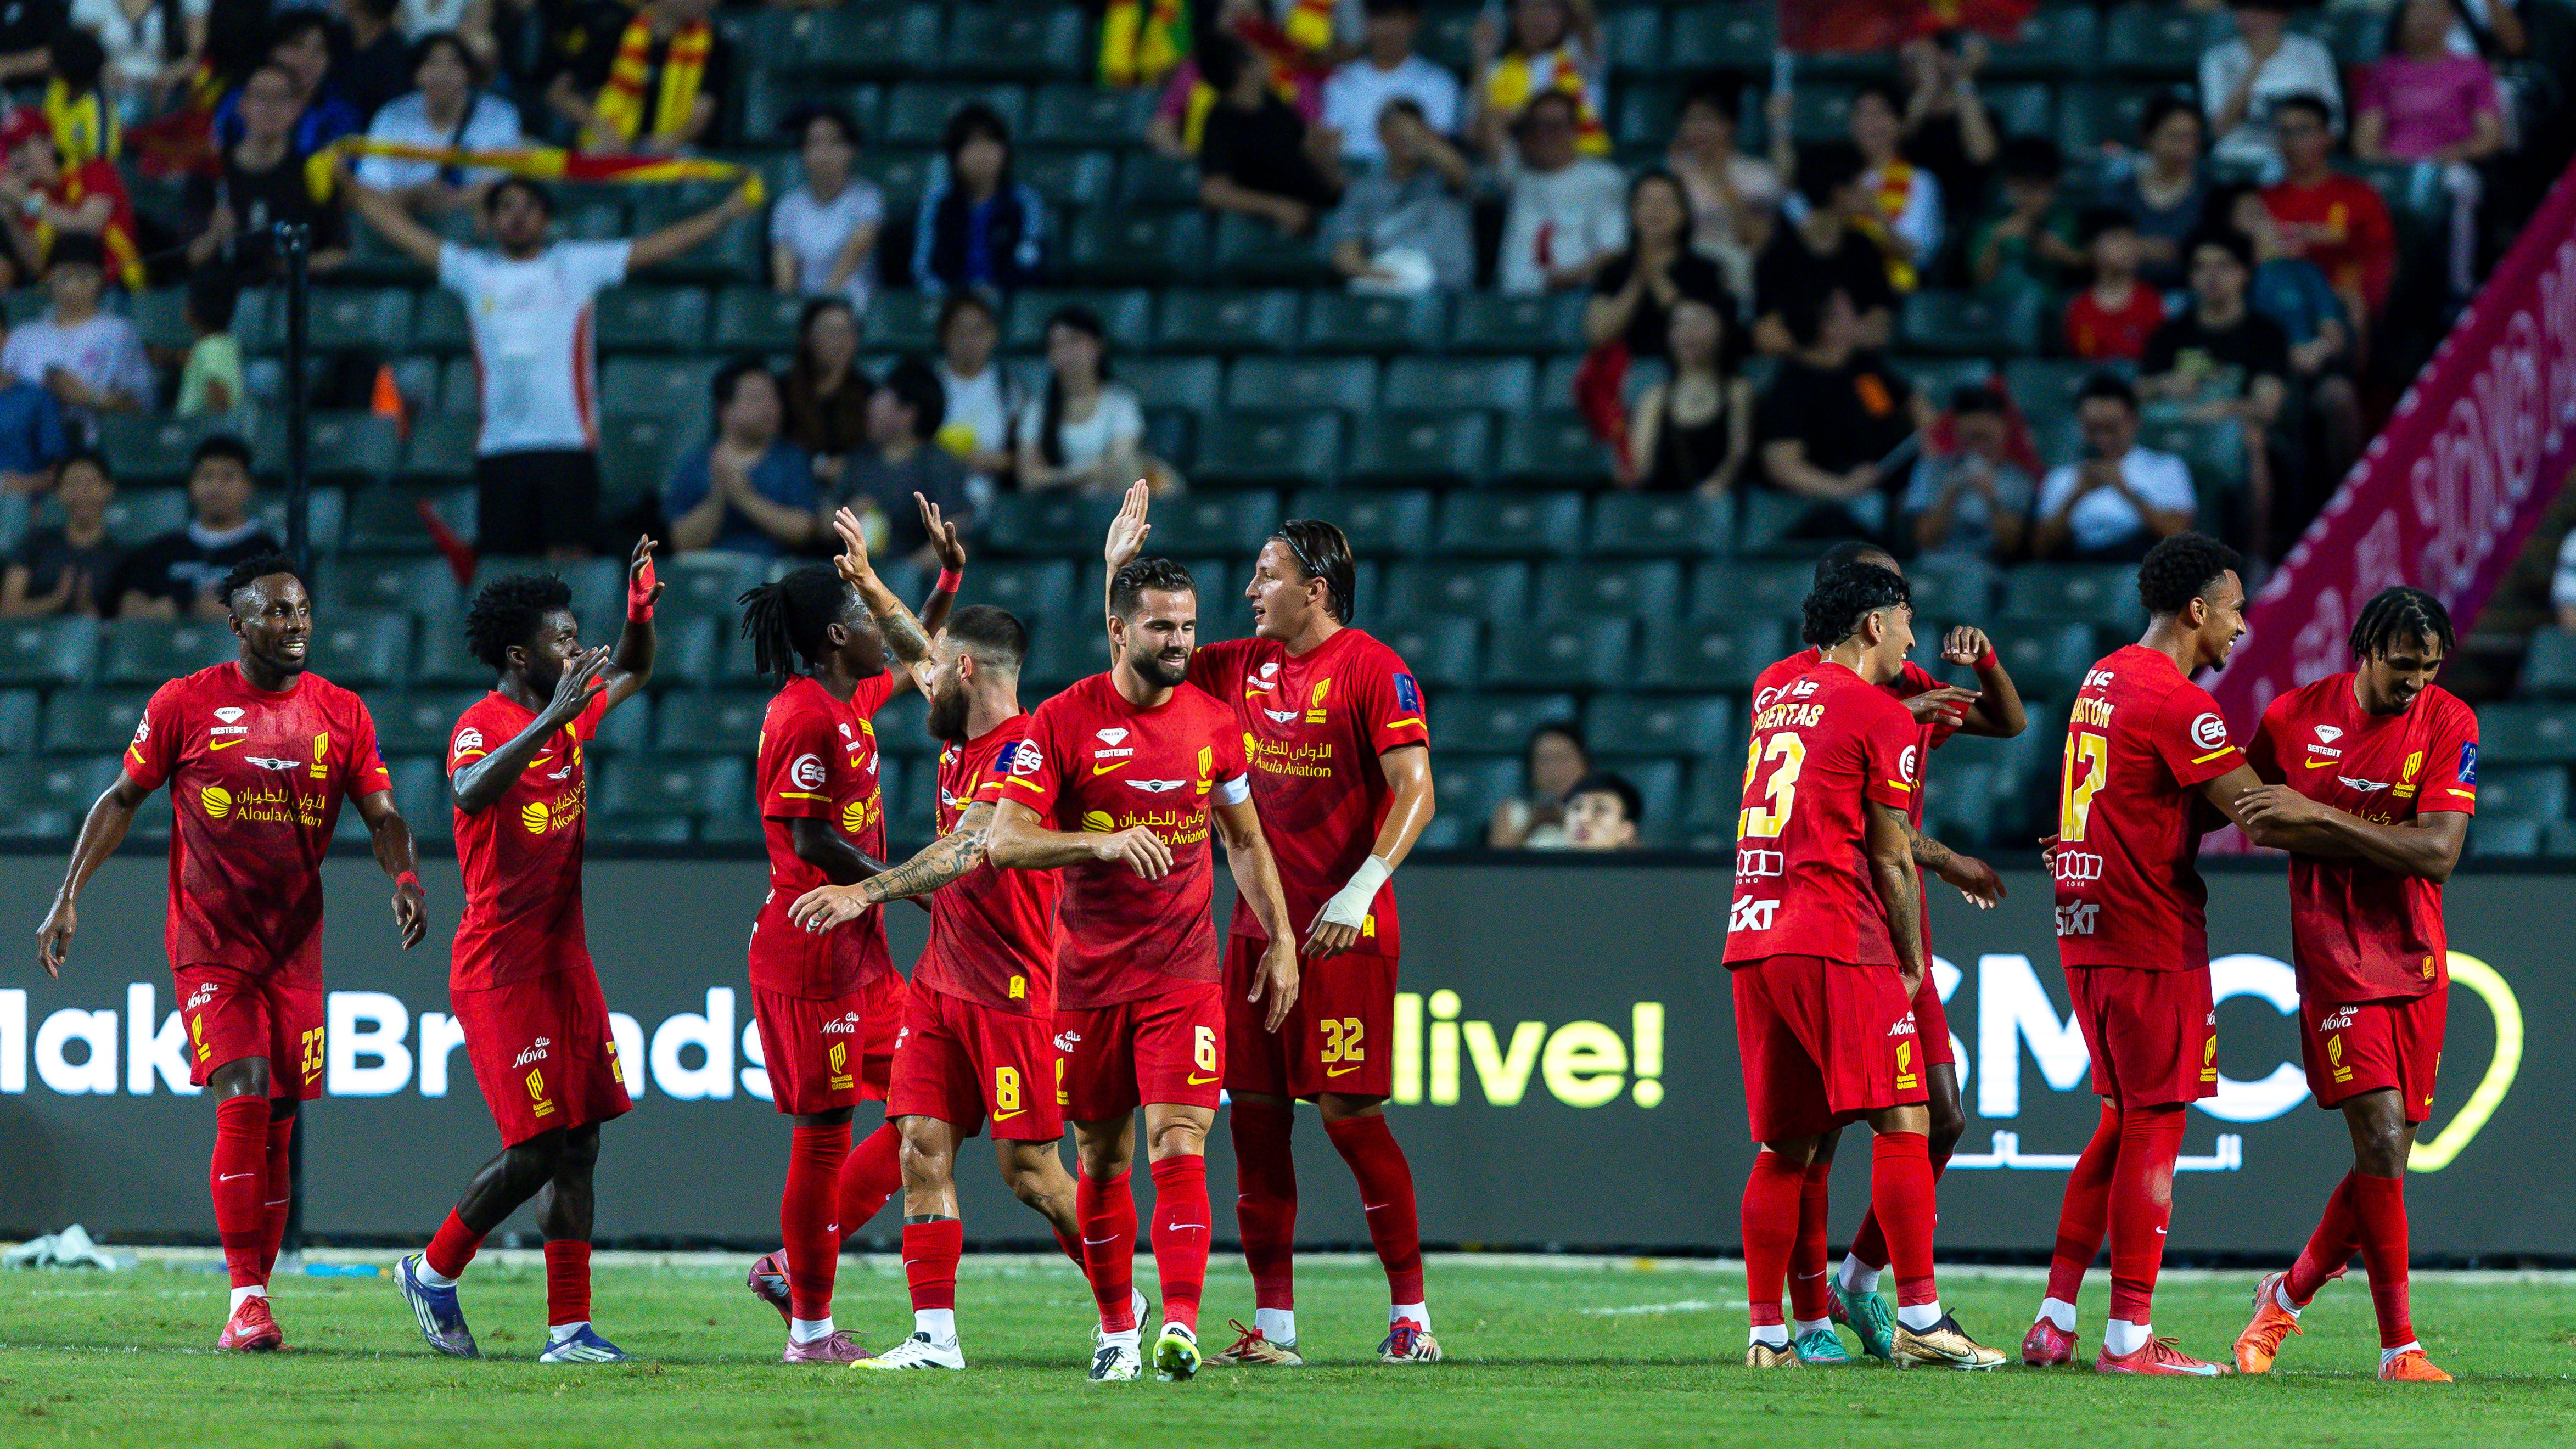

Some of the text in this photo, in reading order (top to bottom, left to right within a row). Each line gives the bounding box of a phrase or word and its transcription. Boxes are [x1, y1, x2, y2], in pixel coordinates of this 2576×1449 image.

[1753, 703, 1825, 737] PUERTAS
[2201, 726, 2227, 742] SG
[1016, 748, 1044, 771] SG
[2307, 743, 2342, 758] BESTEBIT
[800, 763, 825, 782] SG
[1283, 761, 1331, 777] Aviation
[237, 787, 288, 805] للطيران
[1736, 732, 1806, 843] 23
[2061, 731, 2107, 842] 17
[235, 806, 282, 821] Aloula
[185, 990, 212, 1012] Nova
[820, 1018, 855, 1033] Nova
[1887, 1018, 1916, 1036] Nova
[2319, 1013, 2353, 1032] Nova
[301, 1026, 324, 1074] 33
[1053, 1034, 1074, 1052] Nova
[1194, 1025, 1216, 1072] 6
[1321, 1017, 1365, 1062] 32
[1391, 989, 1666, 1109] live!
[512, 1046, 548, 1068] Nova
[996, 1066, 1020, 1110] 8
